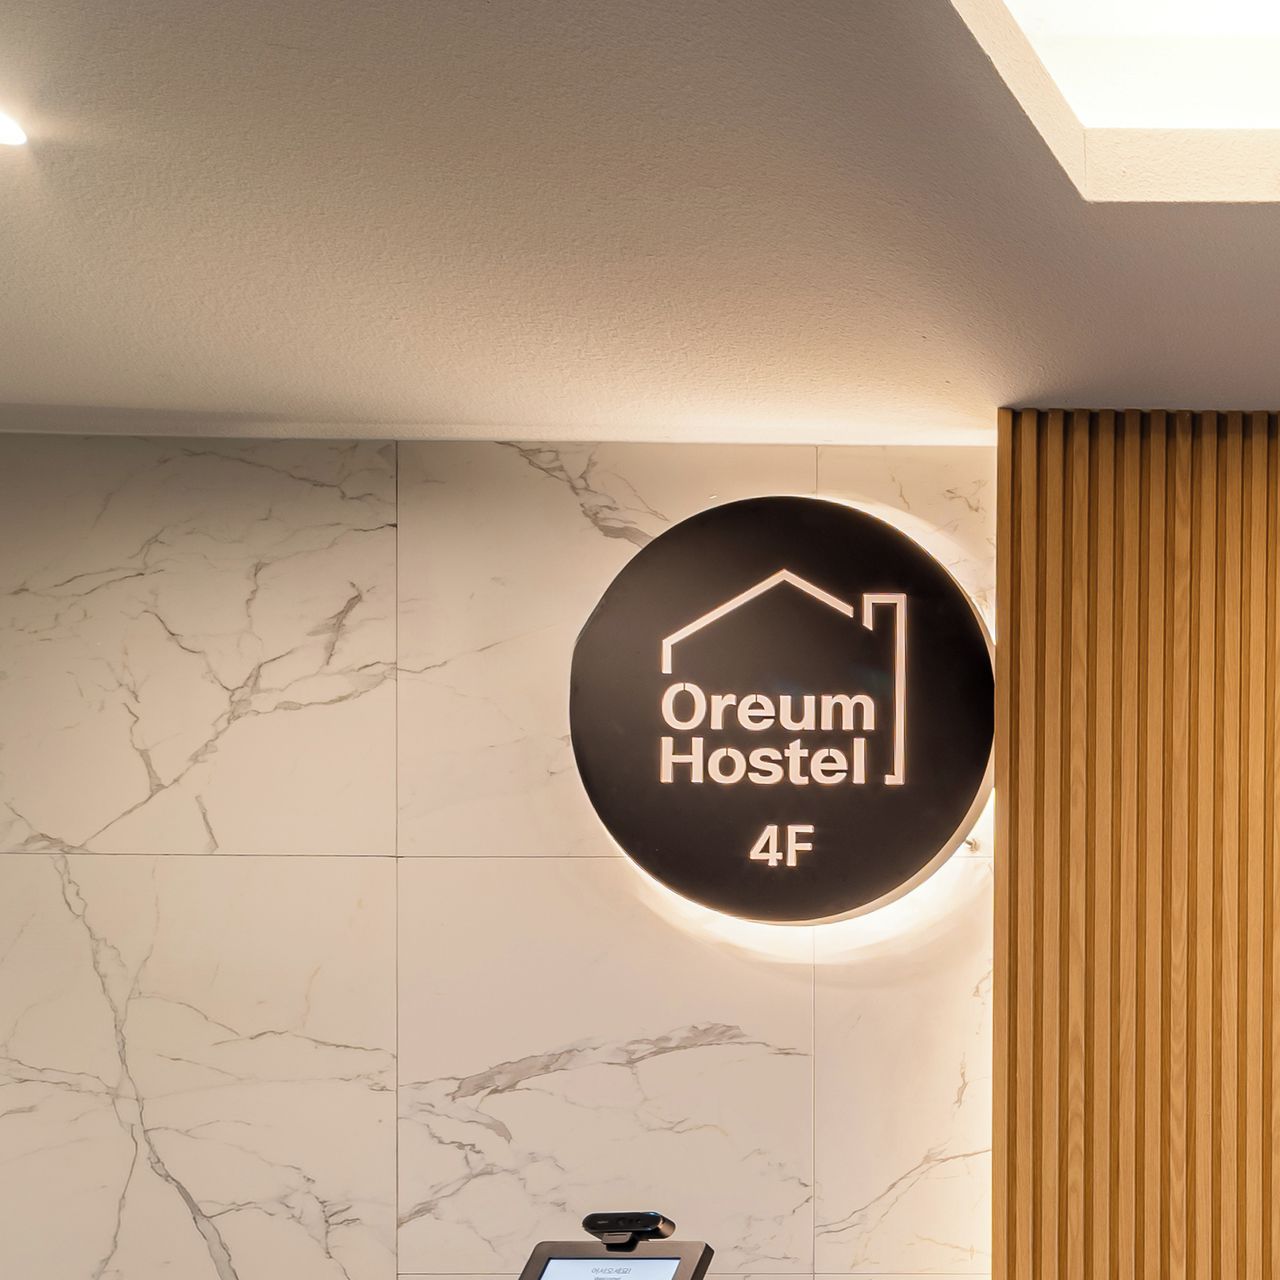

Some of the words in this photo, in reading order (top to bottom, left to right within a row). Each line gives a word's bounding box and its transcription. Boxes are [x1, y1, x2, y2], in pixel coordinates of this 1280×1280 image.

[661, 682, 875, 731] Oreum
[660, 736, 866, 786] Hostel
[749, 824, 814, 867] 4F
